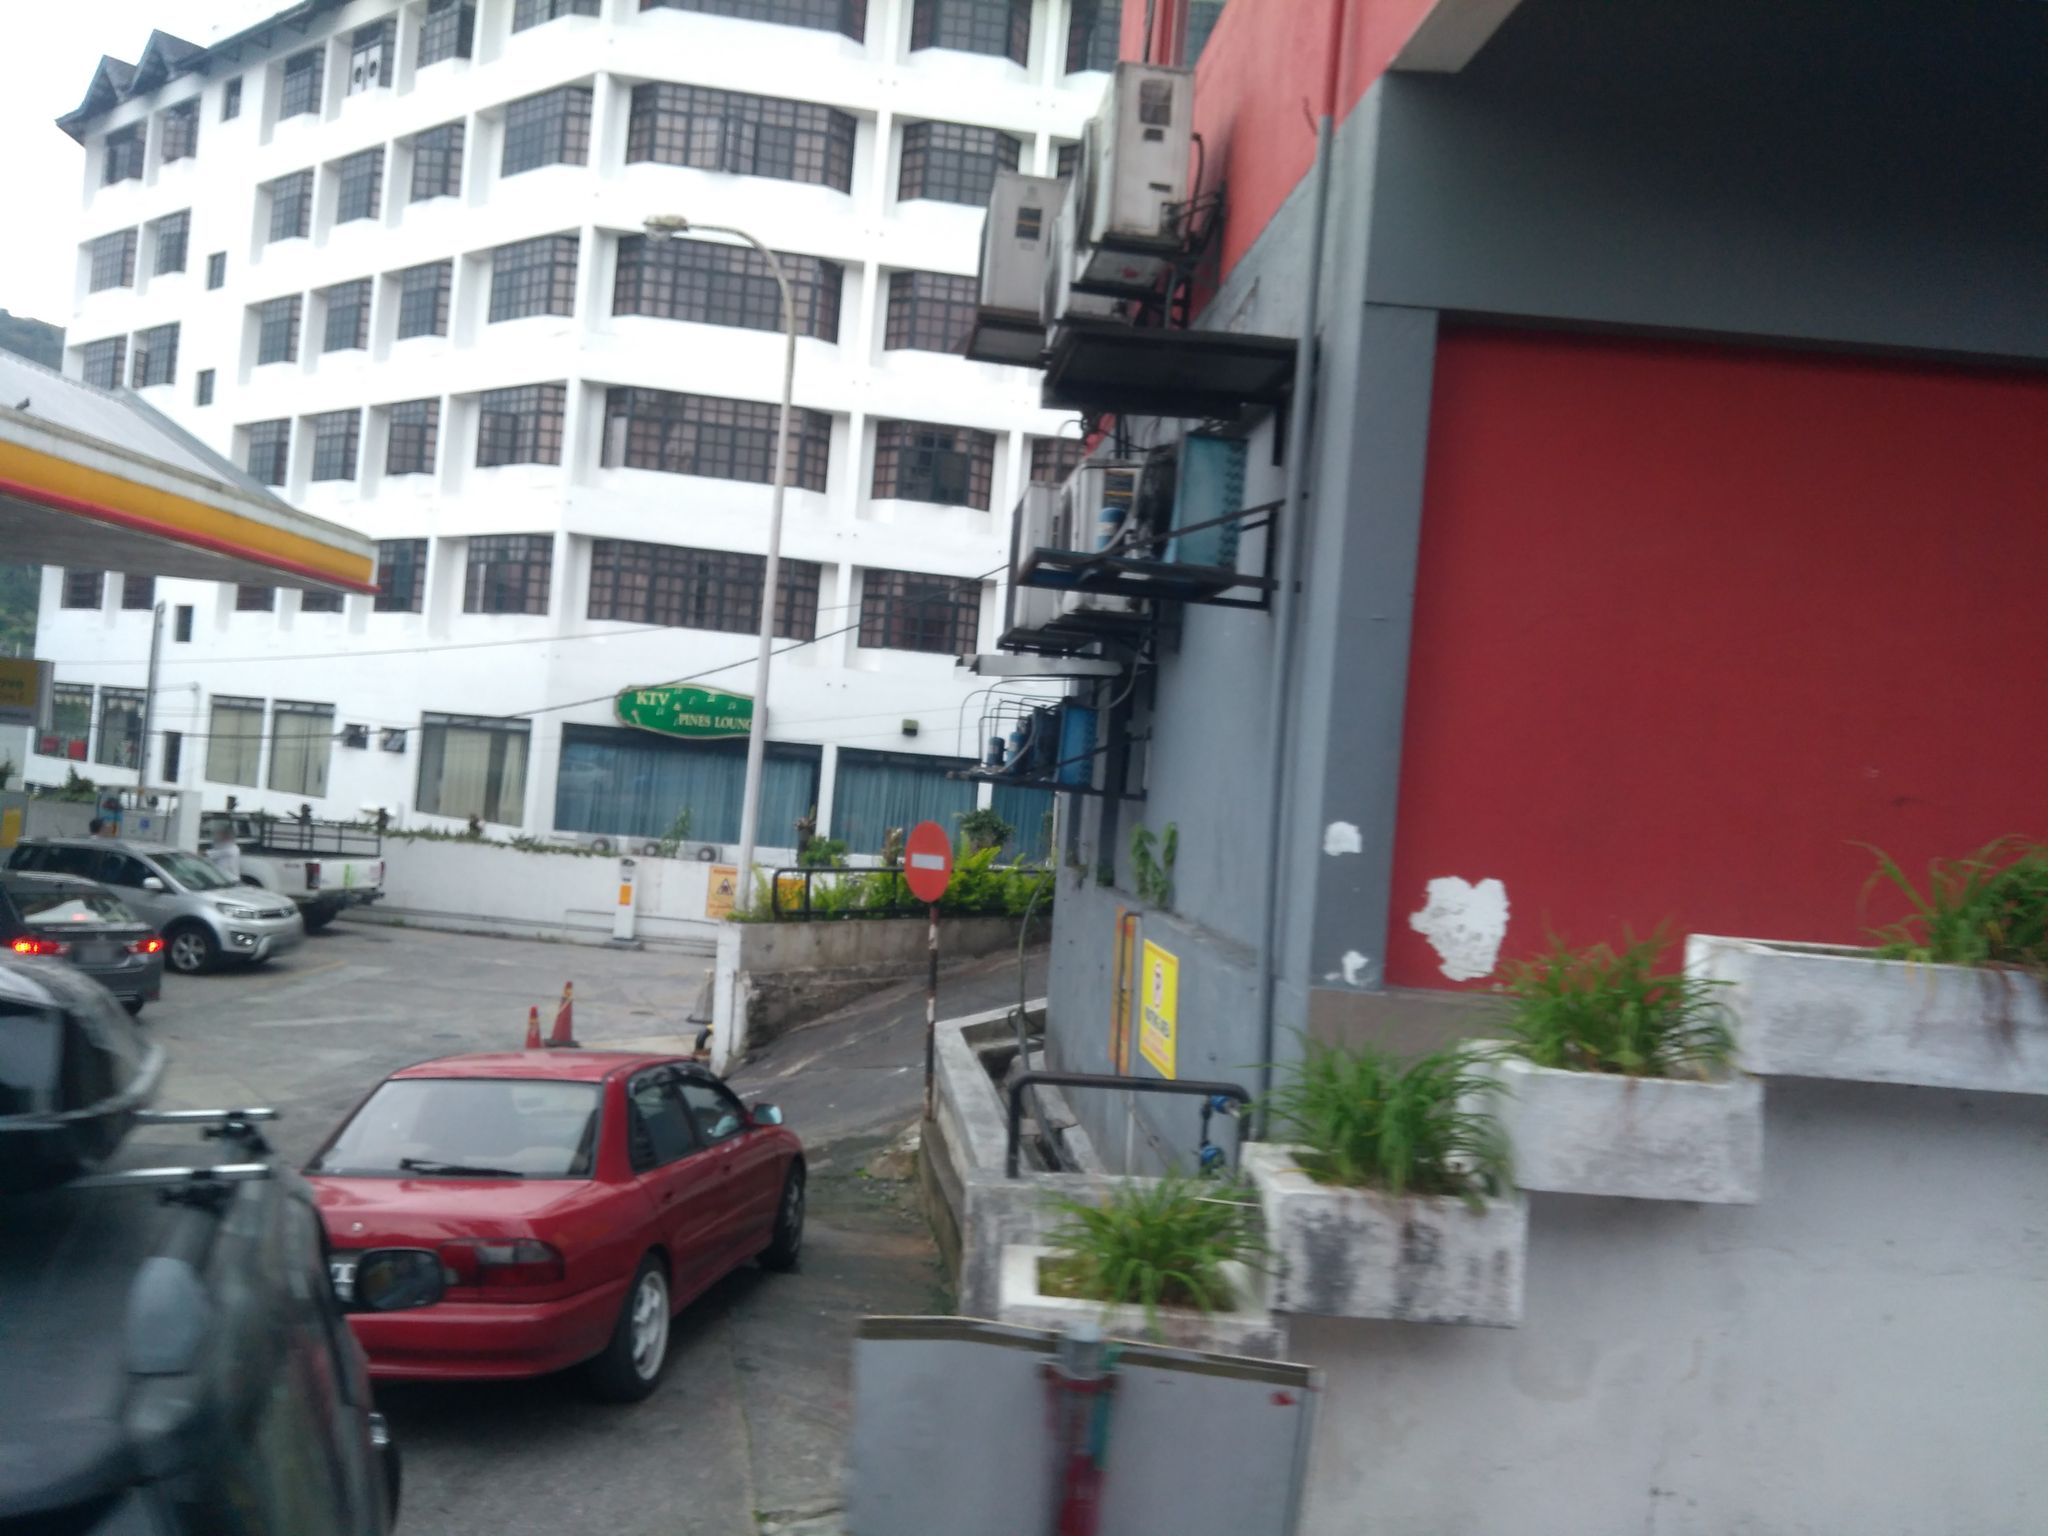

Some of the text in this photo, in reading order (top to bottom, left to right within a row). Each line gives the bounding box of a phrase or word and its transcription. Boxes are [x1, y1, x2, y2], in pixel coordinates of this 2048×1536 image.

[636, 691, 669, 705] KTV
[679, 714, 752, 730] PINES LOUNG
